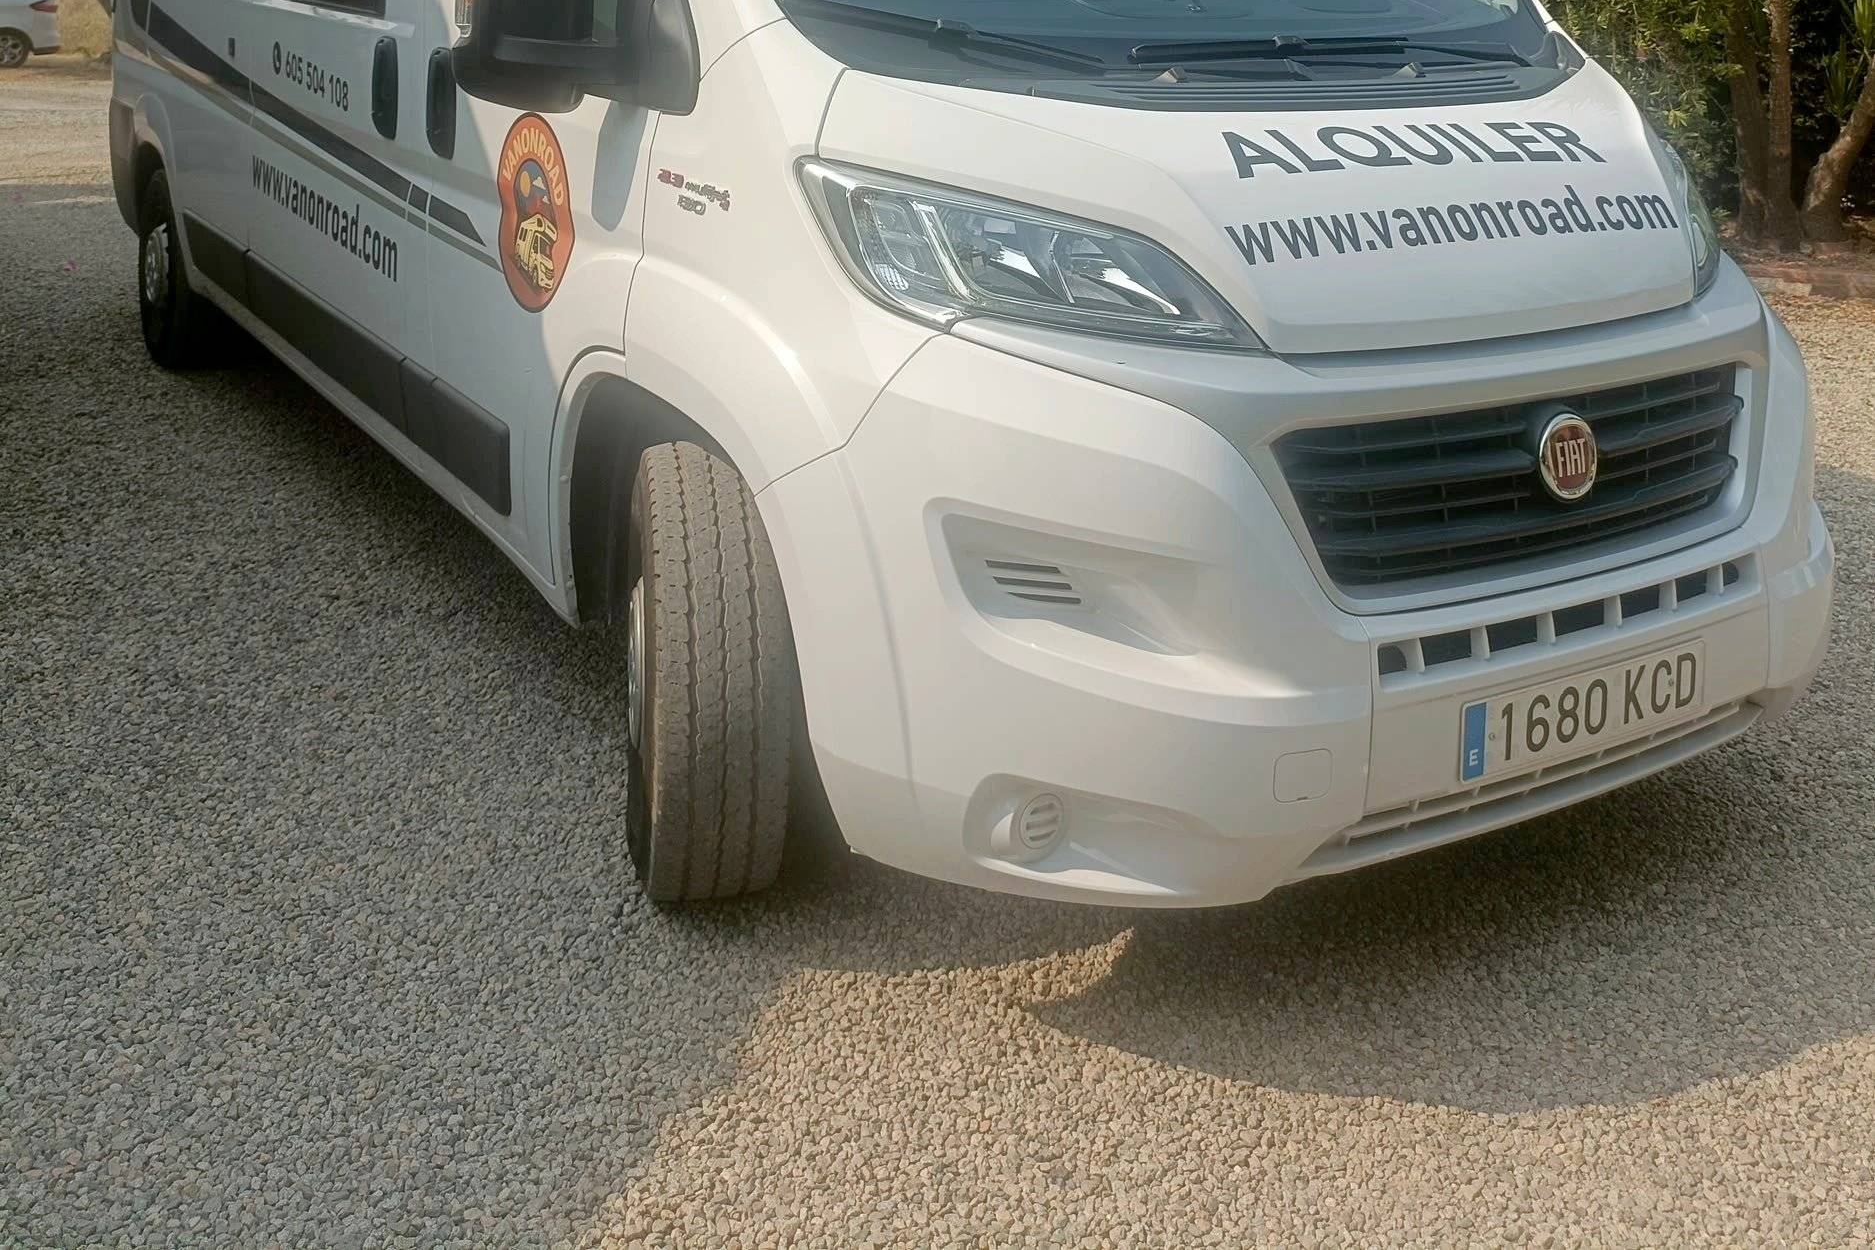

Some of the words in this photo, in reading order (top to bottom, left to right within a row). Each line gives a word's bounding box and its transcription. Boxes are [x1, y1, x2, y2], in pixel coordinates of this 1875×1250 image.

[285, 51, 304, 85] 605
[306, 62, 325, 98] 504
[330, 74, 349, 112] 108
[502, 127, 565, 207] VANONROAD
[1221, 121, 1607, 179] ALQUILER
[252, 155, 398, 282] www.vanonroad.com
[1223, 184, 1679, 267] www.vanonroad.com
[1556, 438, 1586, 478] FIAT
[1468, 748, 1479, 767] E
[1501, 678, 1608, 761] 1680
[1623, 652, 1697, 725] KCD
